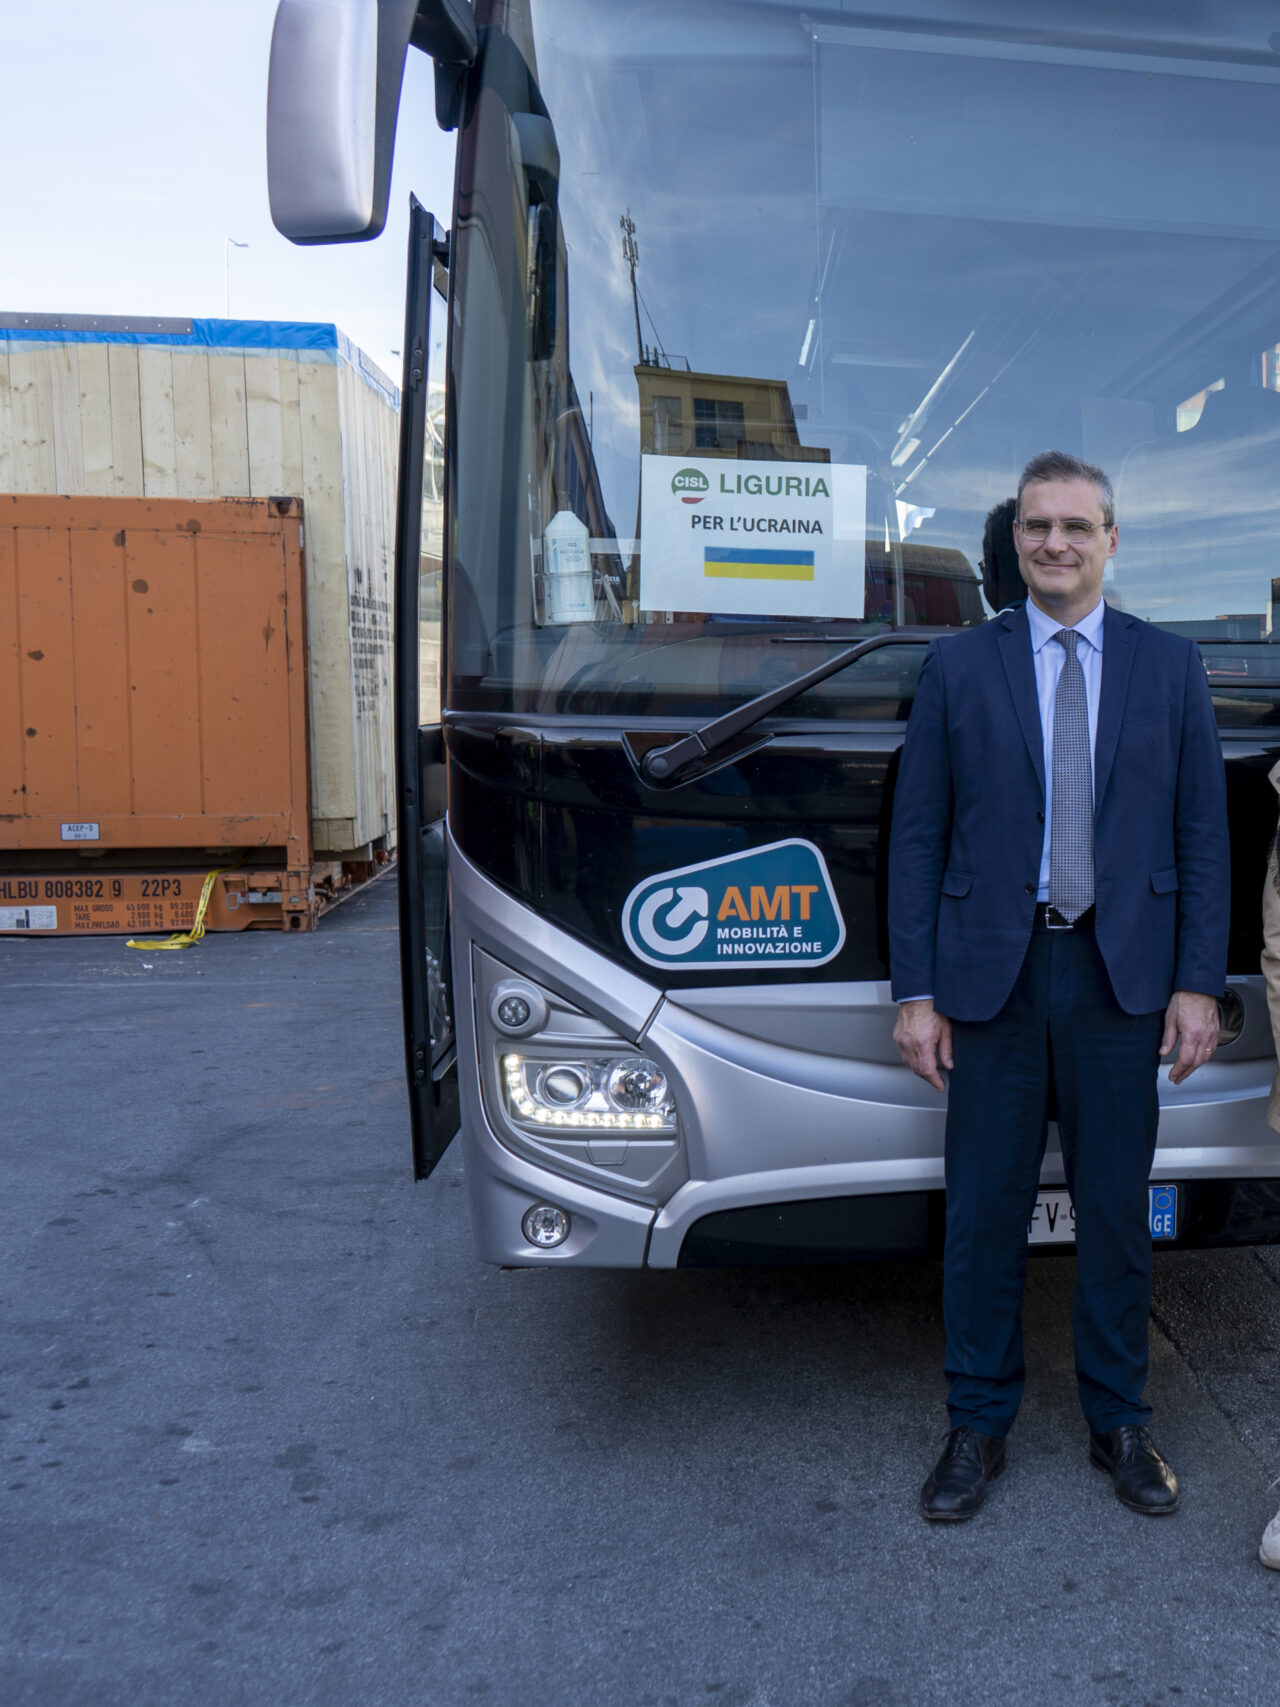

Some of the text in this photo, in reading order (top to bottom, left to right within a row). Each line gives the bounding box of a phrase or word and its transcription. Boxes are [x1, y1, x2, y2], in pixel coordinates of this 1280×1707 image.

[673, 473, 830, 497] CISL LIGURIA
[691, 514, 823, 534] PER L'UCRAINA
[45, 880, 104, 899] 808382
[112, 880, 122, 898] 9
[140, 879, 182, 897] 22P3
[74, 904, 89, 912] MAX
[716, 885, 819, 922] AMT
[75, 912, 91, 921] TARE
[717, 924, 803, 939] MOBILITÀ E
[717, 941, 823, 955] INNOVAZIONE
[1153, 1214, 1171, 1232] GE
